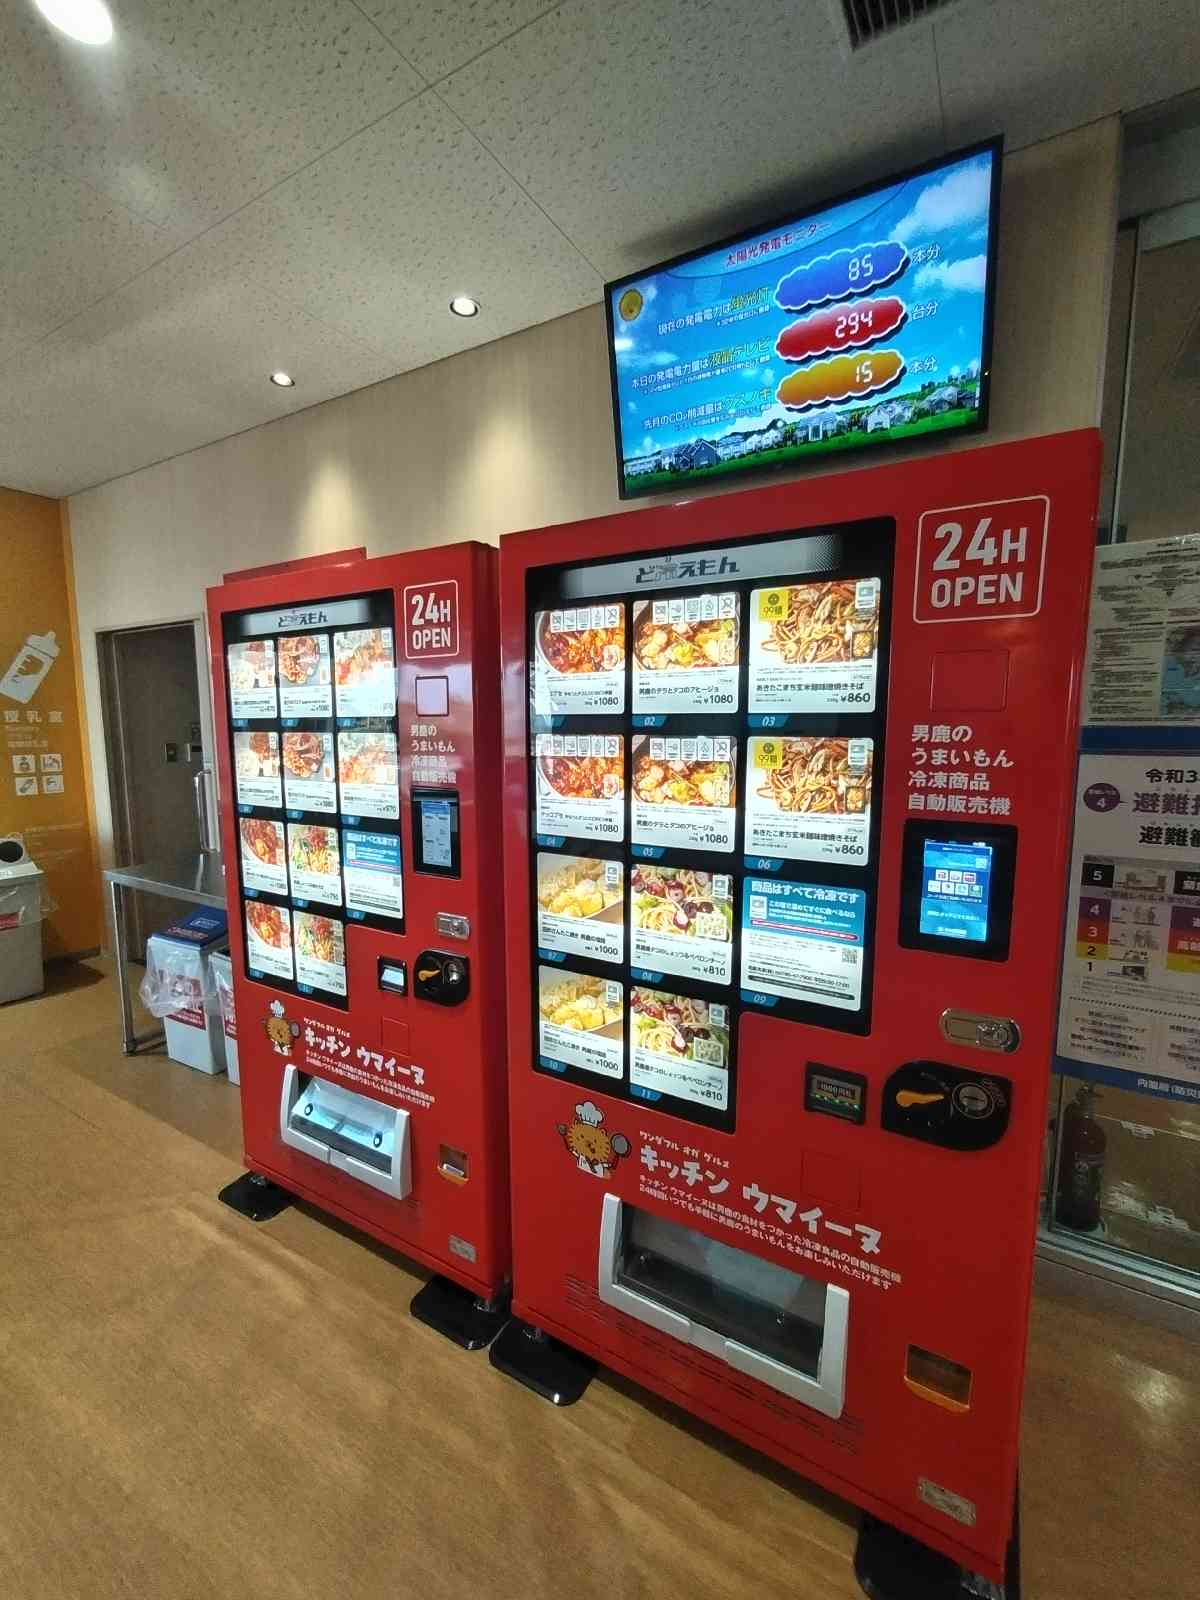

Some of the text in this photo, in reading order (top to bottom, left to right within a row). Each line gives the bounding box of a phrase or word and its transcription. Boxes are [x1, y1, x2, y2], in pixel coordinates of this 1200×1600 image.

[848, 253, 874, 281] 85
[911, 301, 939, 321] 台分
[835, 309, 873, 339] 294
[856, 360, 873, 383] 15
[932, 517, 1028, 571] 24H
[930, 572, 1024, 609] OPEN
[411, 592, 451, 625] 24H
[412, 626, 451, 649] OPEN
[703, 694, 734, 705] ¥1080
[840, 692, 871, 704] ¥860
[644, 717, 656, 727] 02
[762, 715, 776, 727] 03
[911, 724, 973, 743] 男鹿の
[410, 739, 456, 753] うまいもん
[911, 747, 1015, 768] うまいもん
[908, 769, 991, 791] 冷凍商品
[908, 792, 1012, 816] 自動販売機
[594, 822, 619, 833] ¥1080
[699, 832, 729, 844] ¥1080
[835, 844, 864, 856] ¥860
[758, 858, 771, 870] 06
[1092, 870, 1103, 881] 5
[1090, 904, 1100, 915] 4
[1088, 926, 1098, 937] 3
[1087, 946, 1097, 956] 2
[703, 965, 726, 977] ¥810
[1087, 962, 1093, 972] 1
[304, 1026, 351, 1057] キッチン
[356, 1046, 425, 1086] ウマイーヌ
[701, 1089, 723, 1102] ¥810
[639, 1130, 731, 1168] ワンダフル オガ グルメ
[639, 1174, 668, 1192] キッチン
[640, 1144, 882, 1255] キッチン ウマイーヌ
